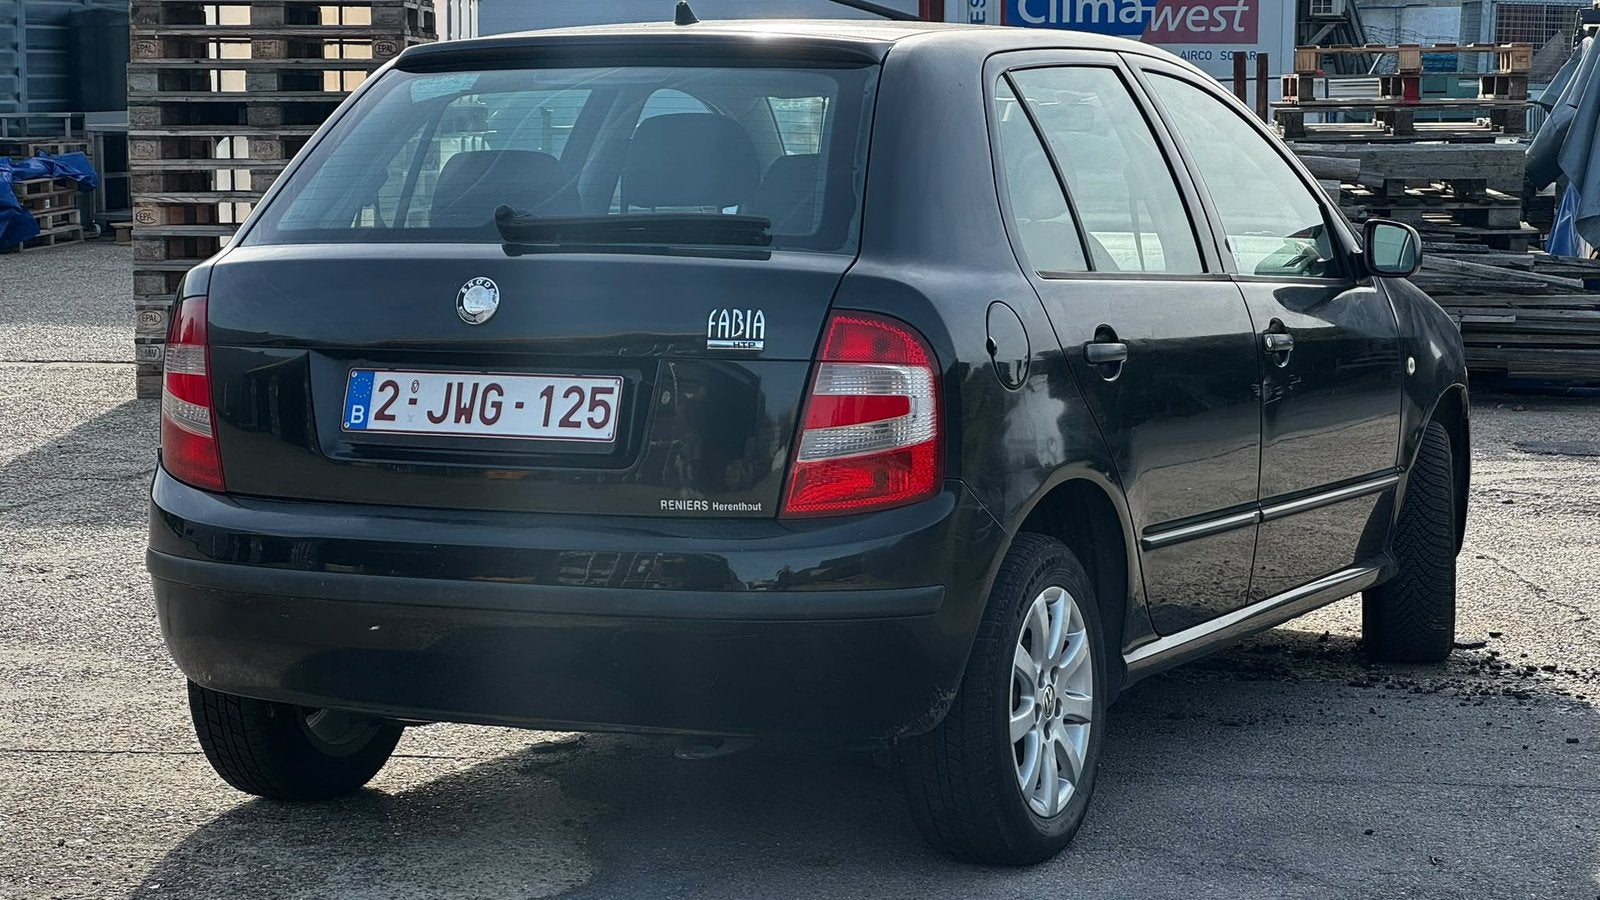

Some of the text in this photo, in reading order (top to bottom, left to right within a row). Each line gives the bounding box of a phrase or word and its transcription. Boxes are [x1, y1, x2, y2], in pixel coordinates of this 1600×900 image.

[1180, 50, 1212, 60] AIRCO
[141, 314, 158, 322] EPAL
[707, 308, 765, 339] FABIA
[733, 341, 756, 349] HTP
[350, 404, 365, 424] B
[660, 500, 762, 511] RENIERS Herenthout
